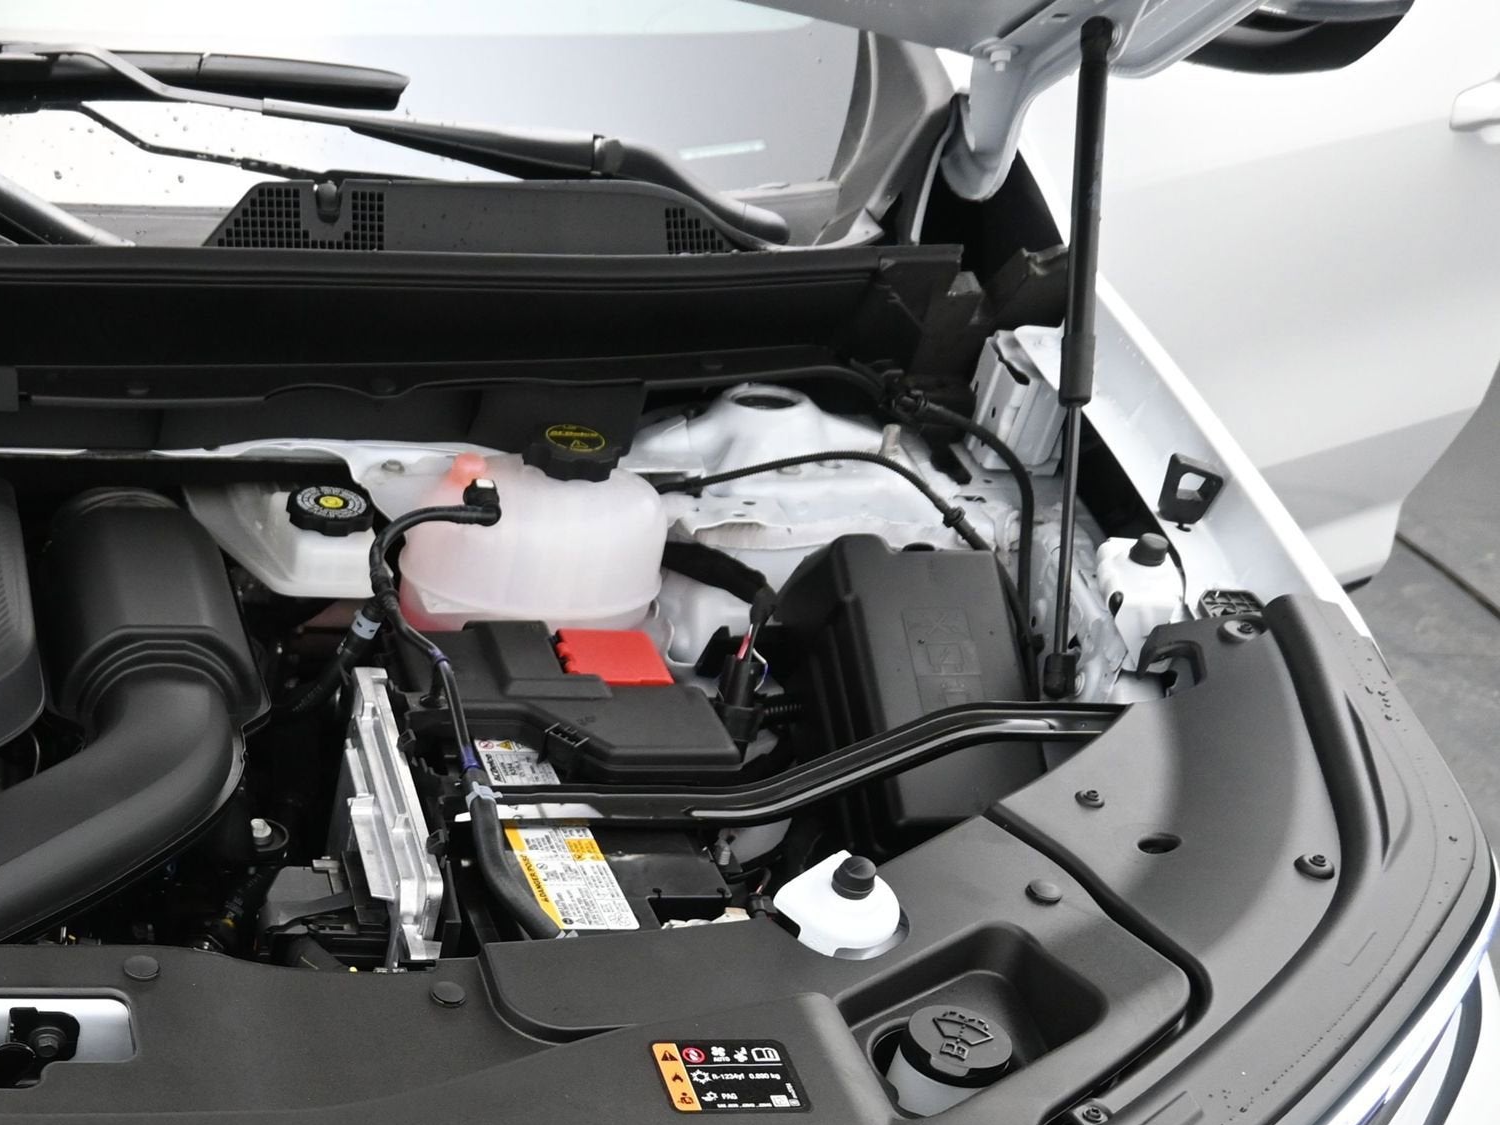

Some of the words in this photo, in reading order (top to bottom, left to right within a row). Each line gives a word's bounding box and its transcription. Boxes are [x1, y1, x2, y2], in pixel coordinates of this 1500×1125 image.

[485, 753, 502, 782] ACDelco
[711, 1073, 745, 1081] R-1234yf
[770, 1073, 781, 1081] kg
[721, 1093, 739, 1101] PAG
